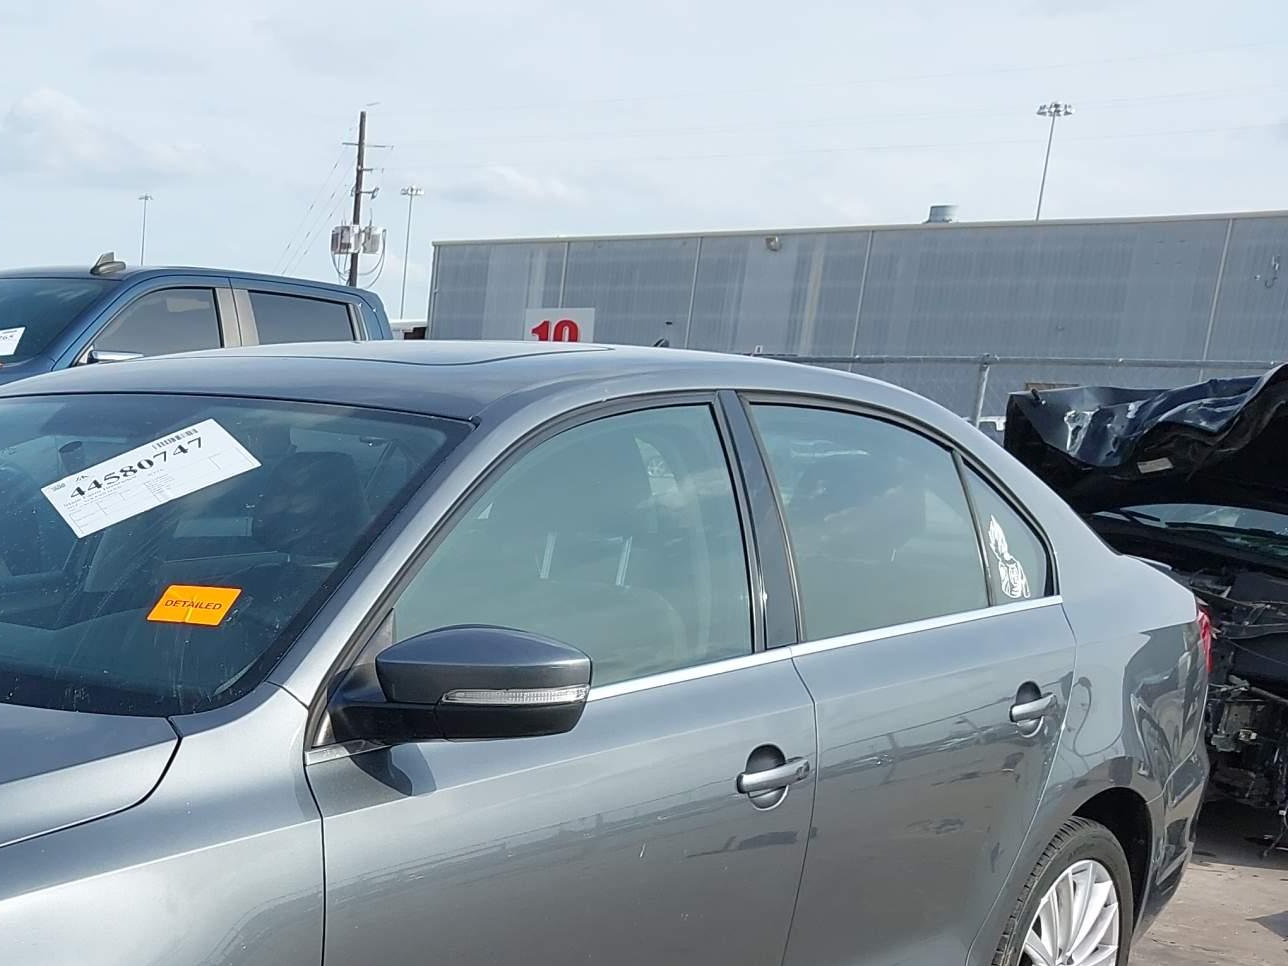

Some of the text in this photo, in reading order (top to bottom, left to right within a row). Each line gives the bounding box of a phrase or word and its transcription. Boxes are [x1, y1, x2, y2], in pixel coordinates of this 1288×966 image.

[531, 320, 579, 342] 10
[70, 437, 202, 498] 44580747
[164, 599, 222, 611] DETAILED
